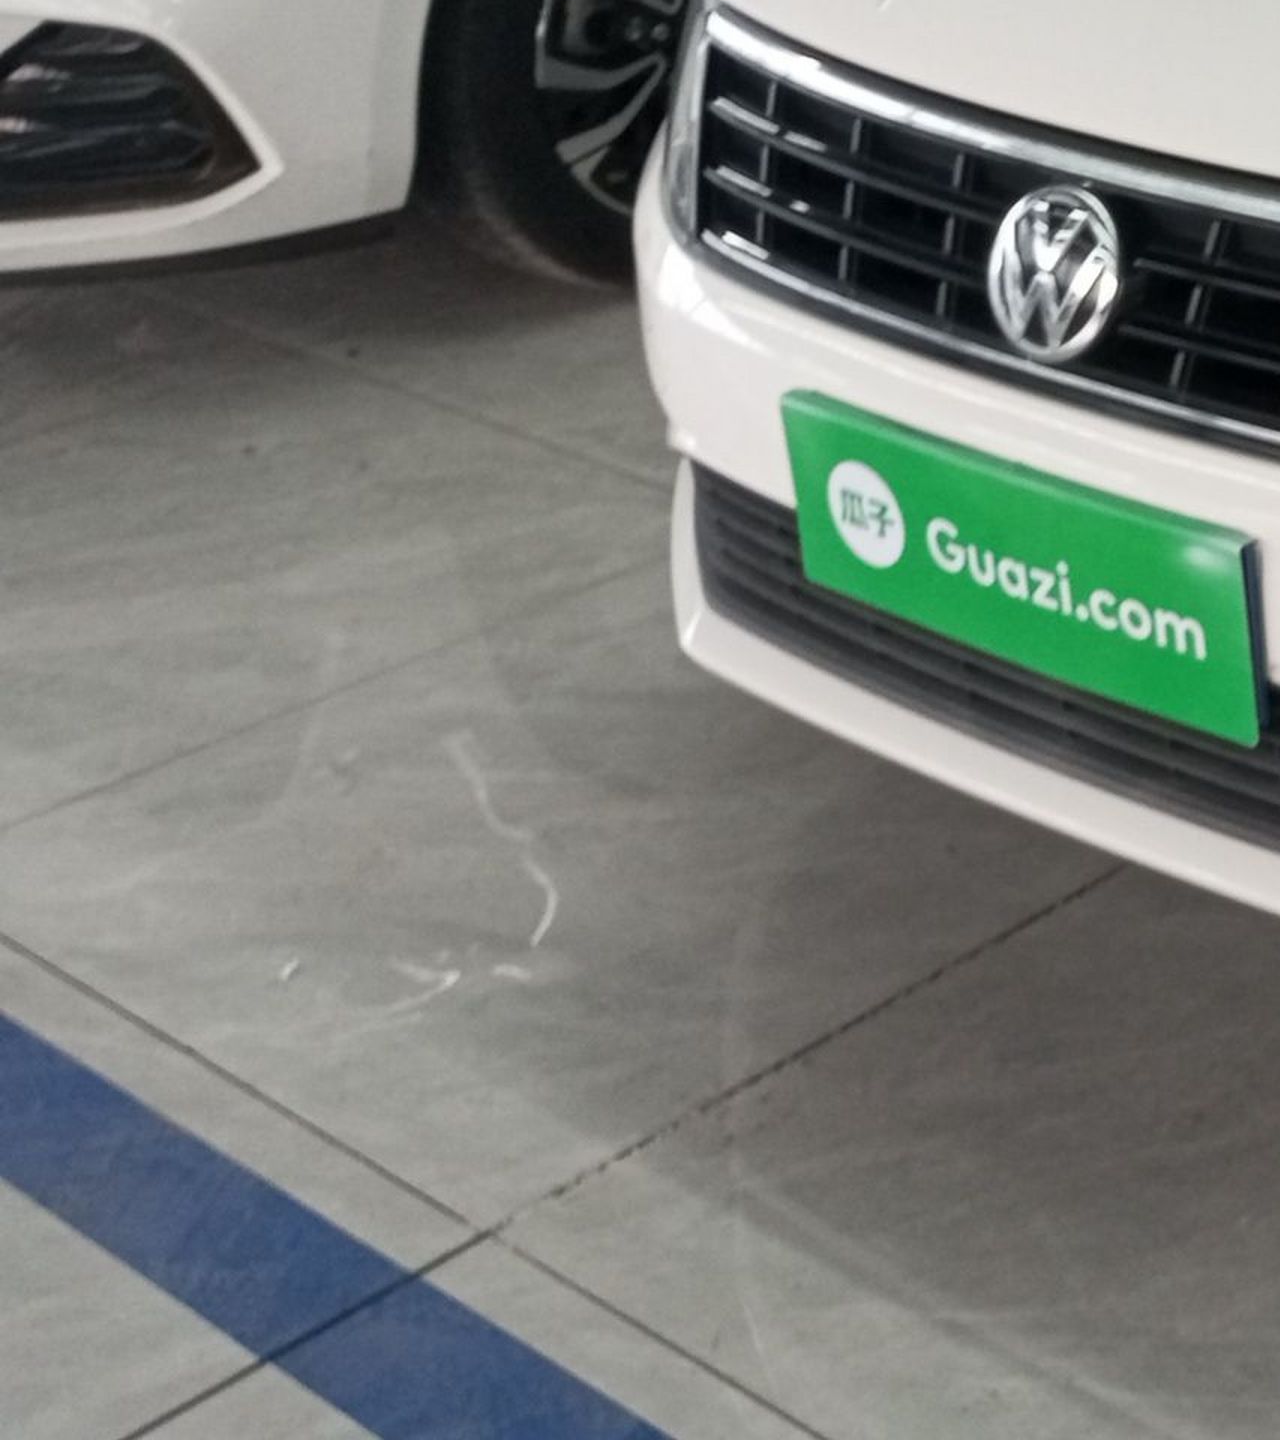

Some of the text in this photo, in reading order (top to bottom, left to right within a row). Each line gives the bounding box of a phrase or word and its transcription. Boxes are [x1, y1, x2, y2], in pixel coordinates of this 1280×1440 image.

[1001, 199, 1107, 349] VW
[841, 487, 895, 538] 瓜子
[926, 517, 1208, 660] Guazi.com
